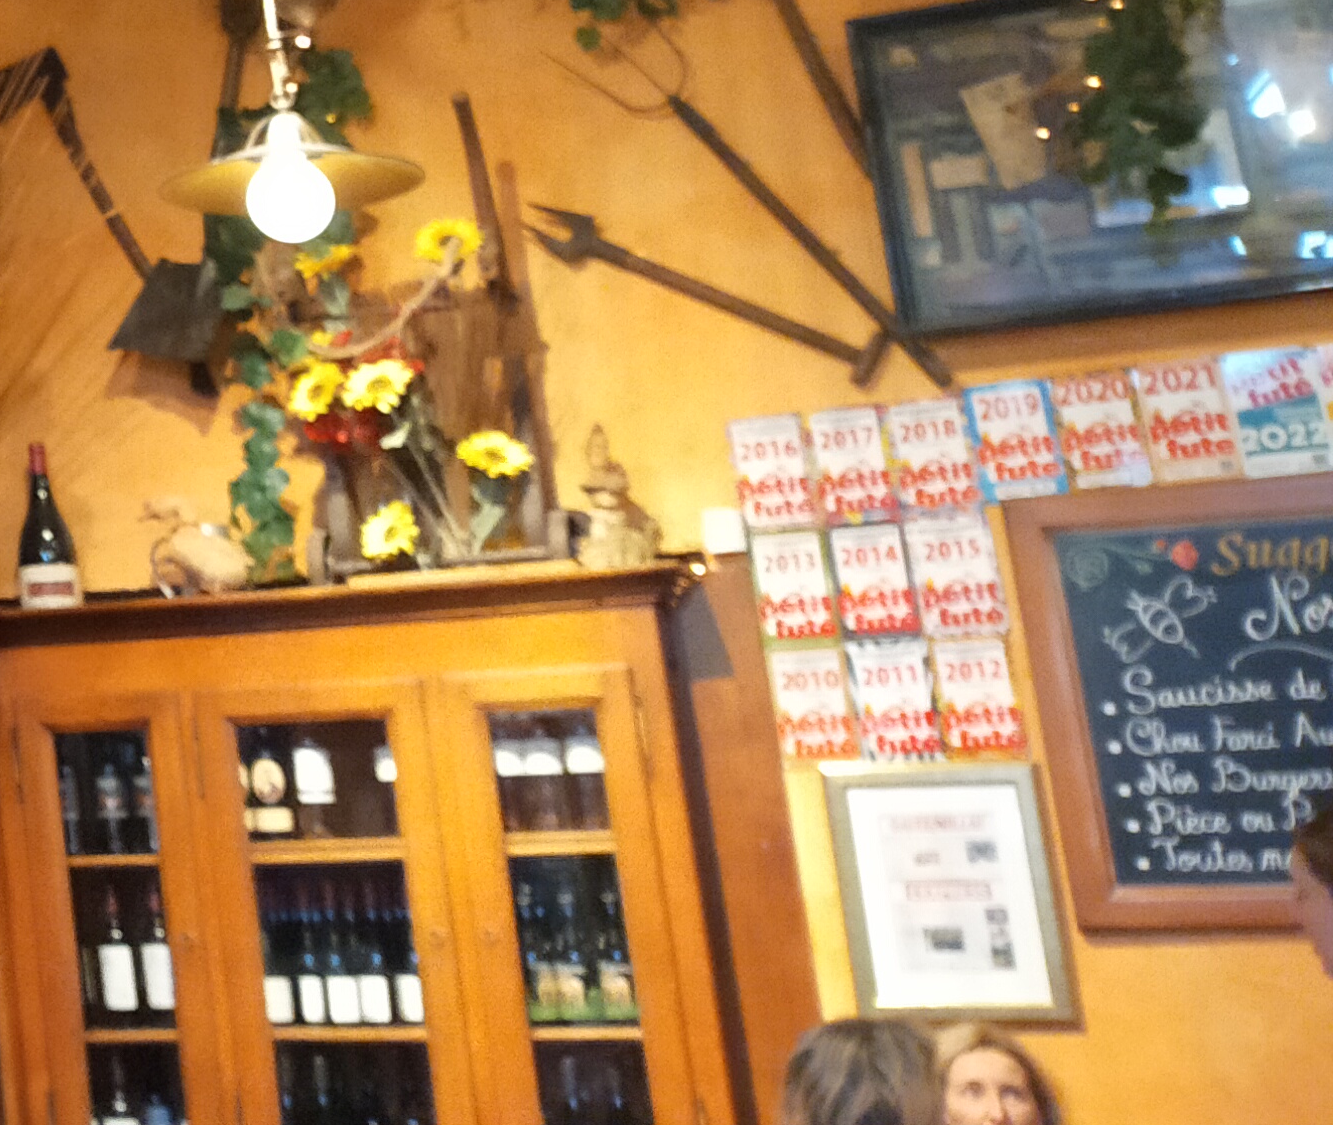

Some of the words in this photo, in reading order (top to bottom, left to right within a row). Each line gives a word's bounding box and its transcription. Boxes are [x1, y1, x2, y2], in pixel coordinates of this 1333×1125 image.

[1143, 363, 1218, 395] 2021
[1056, 376, 1130, 407] 2020
[978, 392, 1039, 422] 2019
[820, 426, 875, 451] 2017
[900, 419, 957, 443] 2018
[1239, 421, 1326, 454] 2022
[739, 440, 798, 462] 2016
[841, 545, 899, 567] 2014
[924, 538, 981, 562] 2015
[764, 551, 817, 574] 2013
[783, 670, 839, 692] 2010
[861, 663, 918, 686] 2011
[946, 659, 1002, 681] 2012
[1121, 664, 1278, 715] Saucisse
[1288, 666, 1328, 702] de
[1125, 715, 1205, 757] Chou
[1137, 757, 1200, 796] Nos
[1240, 810, 1278, 833] ou
[1150, 835, 1254, 873] Toutes
